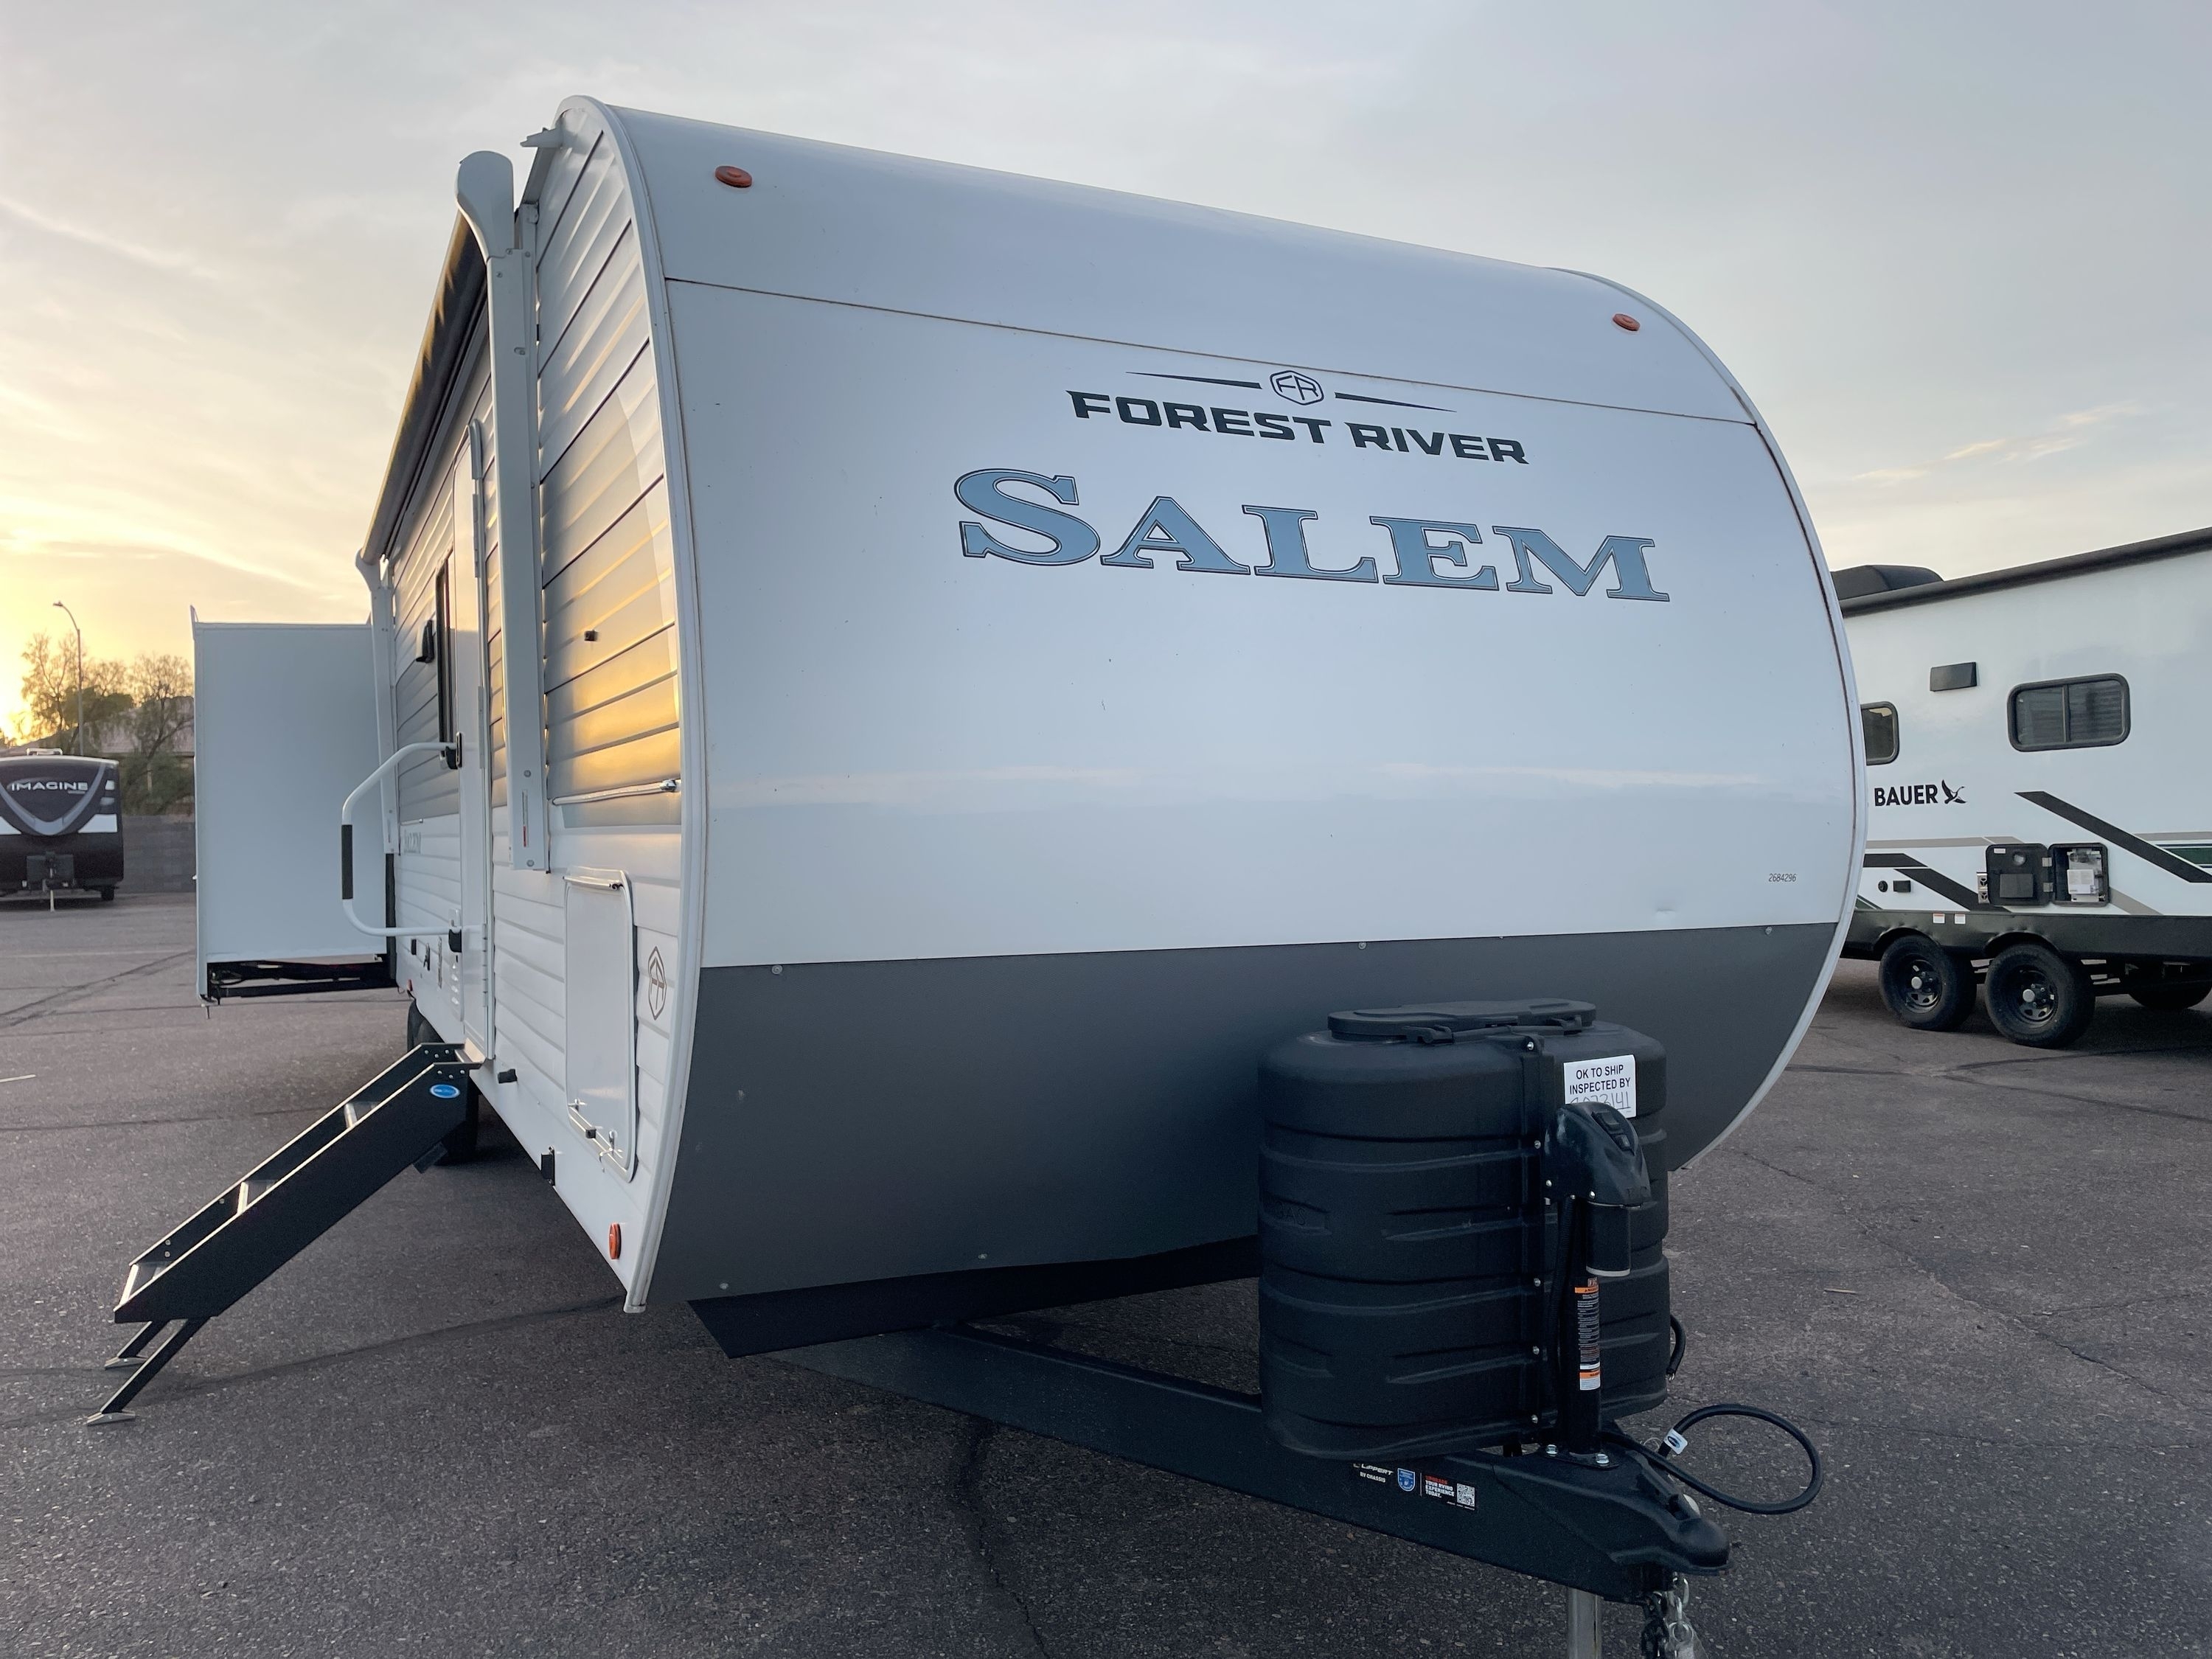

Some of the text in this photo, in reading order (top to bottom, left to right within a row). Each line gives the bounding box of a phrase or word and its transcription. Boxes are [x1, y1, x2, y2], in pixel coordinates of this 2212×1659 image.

[1065, 390, 1530, 465] FOREST RIVER
[954, 467, 1671, 602] SALEM
[11, 782, 88, 791] IMAGINE
[1874, 784, 1938, 807] BAUER
[1768, 873, 1797, 883] 2684296
[1576, 1064, 1624, 1079] OK TO SHIP
[1569, 1077, 1631, 1094] INSPECTED BY
